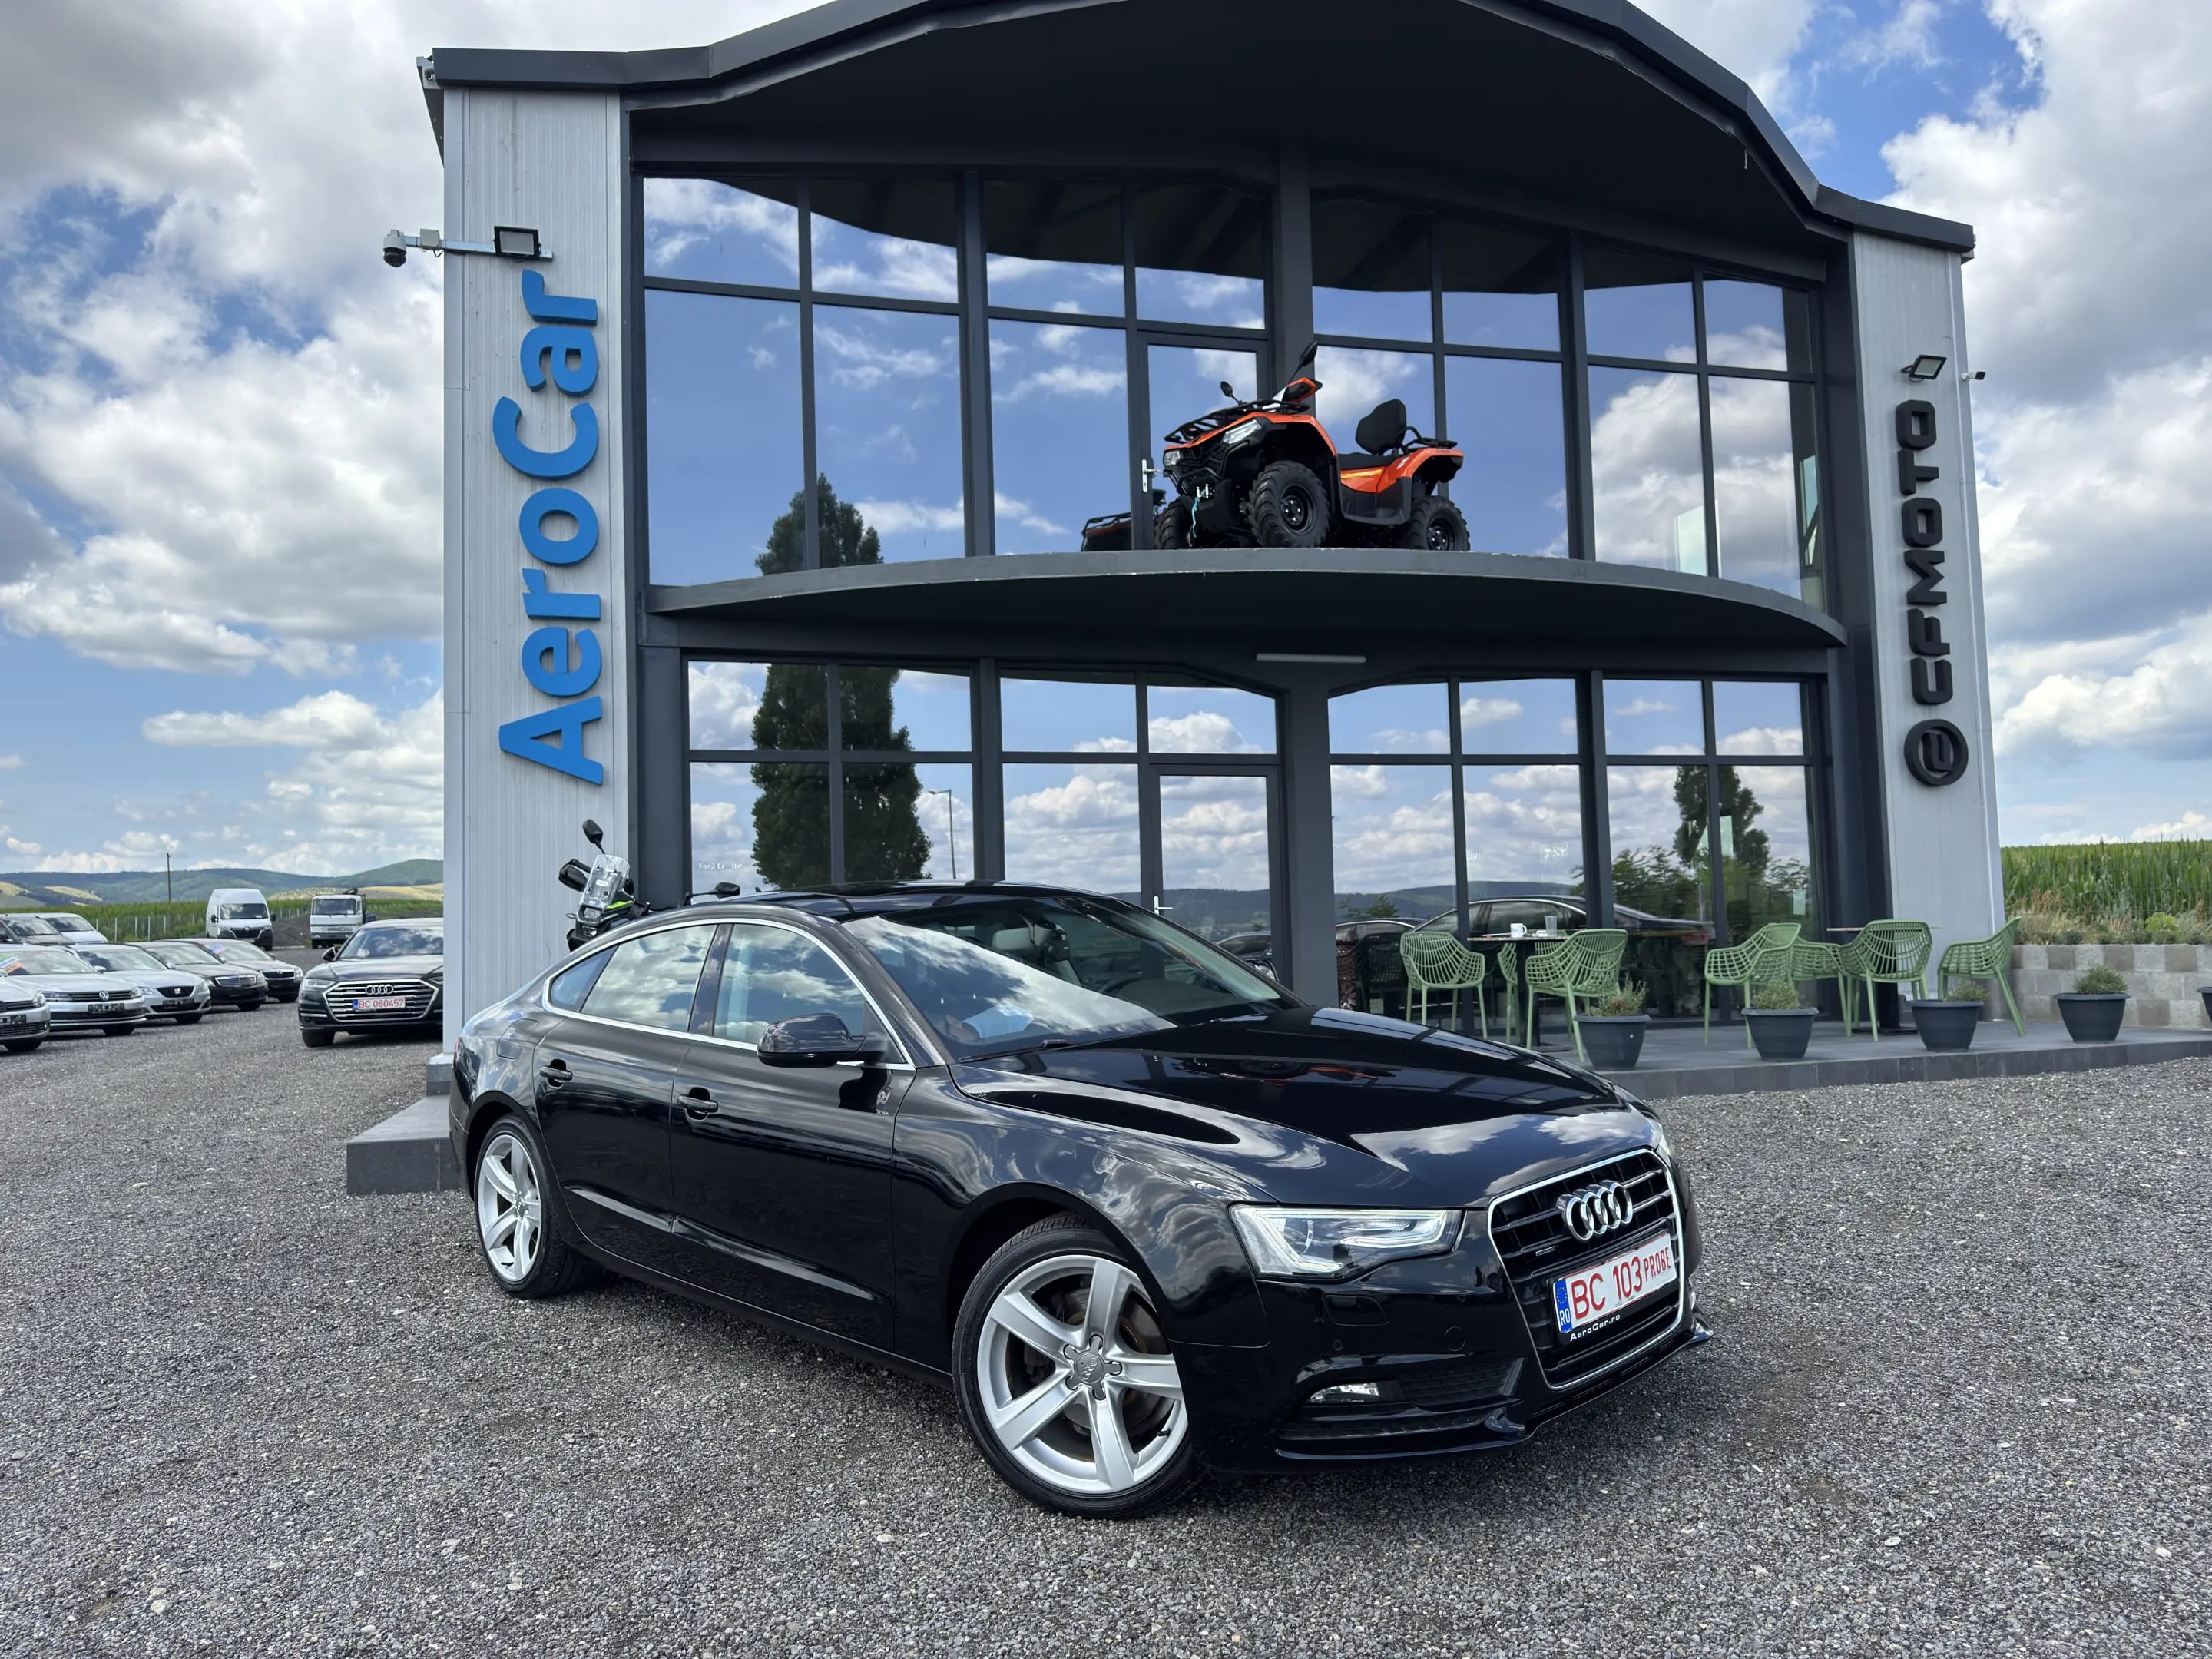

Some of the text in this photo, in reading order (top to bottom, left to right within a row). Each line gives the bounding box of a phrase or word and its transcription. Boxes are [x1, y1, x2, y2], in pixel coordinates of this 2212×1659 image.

[492, 269, 603, 786] AeroCar
[1896, 399, 1954, 705] CFMOTO
[1559, 1308, 1571, 1326] RO
[1571, 1247, 1671, 1320] BC 103 PROBE
[1569, 1314, 1621, 1342] AeroCar.ro
